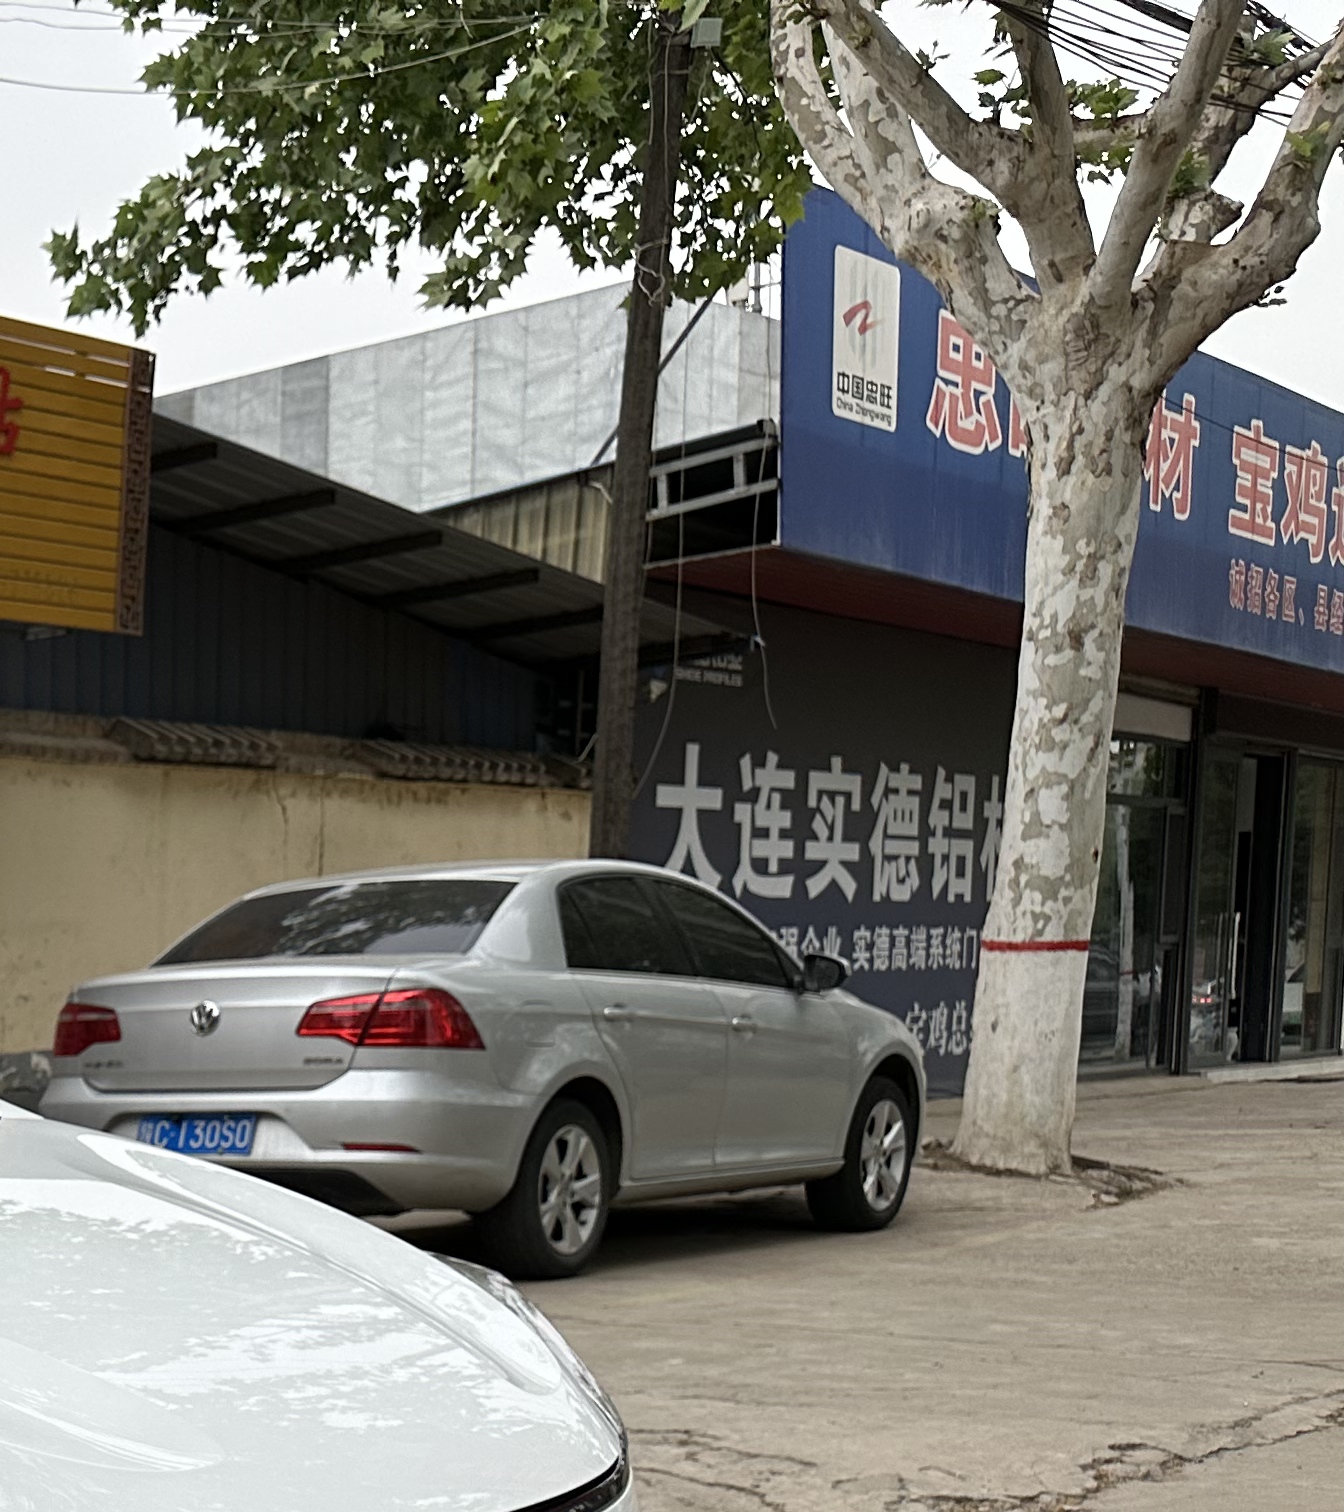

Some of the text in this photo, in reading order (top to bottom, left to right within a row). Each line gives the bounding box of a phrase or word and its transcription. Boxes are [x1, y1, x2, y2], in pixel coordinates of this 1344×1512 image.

[836, 370, 893, 410] 中国忠旺
[852, 924, 983, 972] 实德高端系统门
